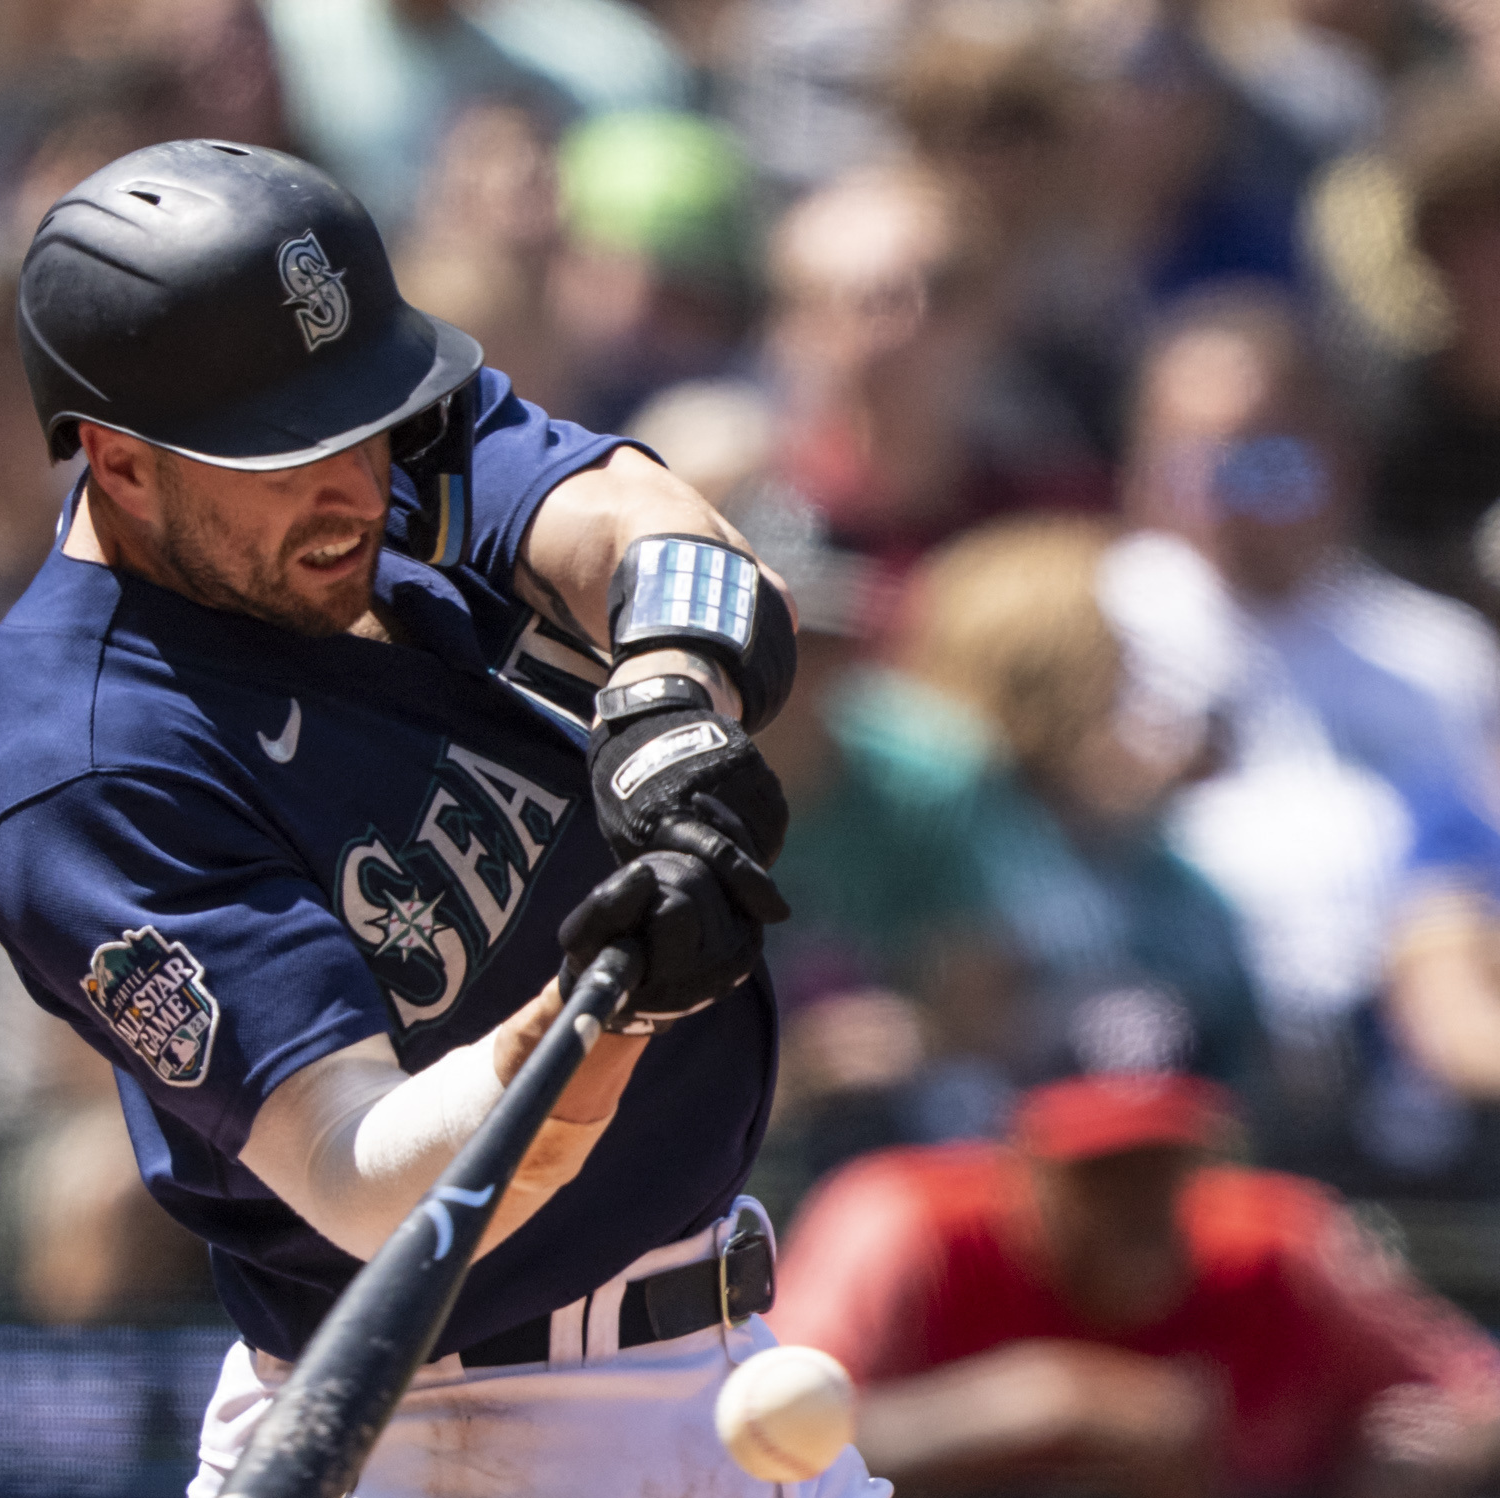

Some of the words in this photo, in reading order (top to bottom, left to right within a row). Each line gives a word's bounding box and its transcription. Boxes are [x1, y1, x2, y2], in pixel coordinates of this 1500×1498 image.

[275, 229, 350, 352] S
[112, 966, 147, 1011] SEATTLE
[139, 992, 192, 1058] GAME
